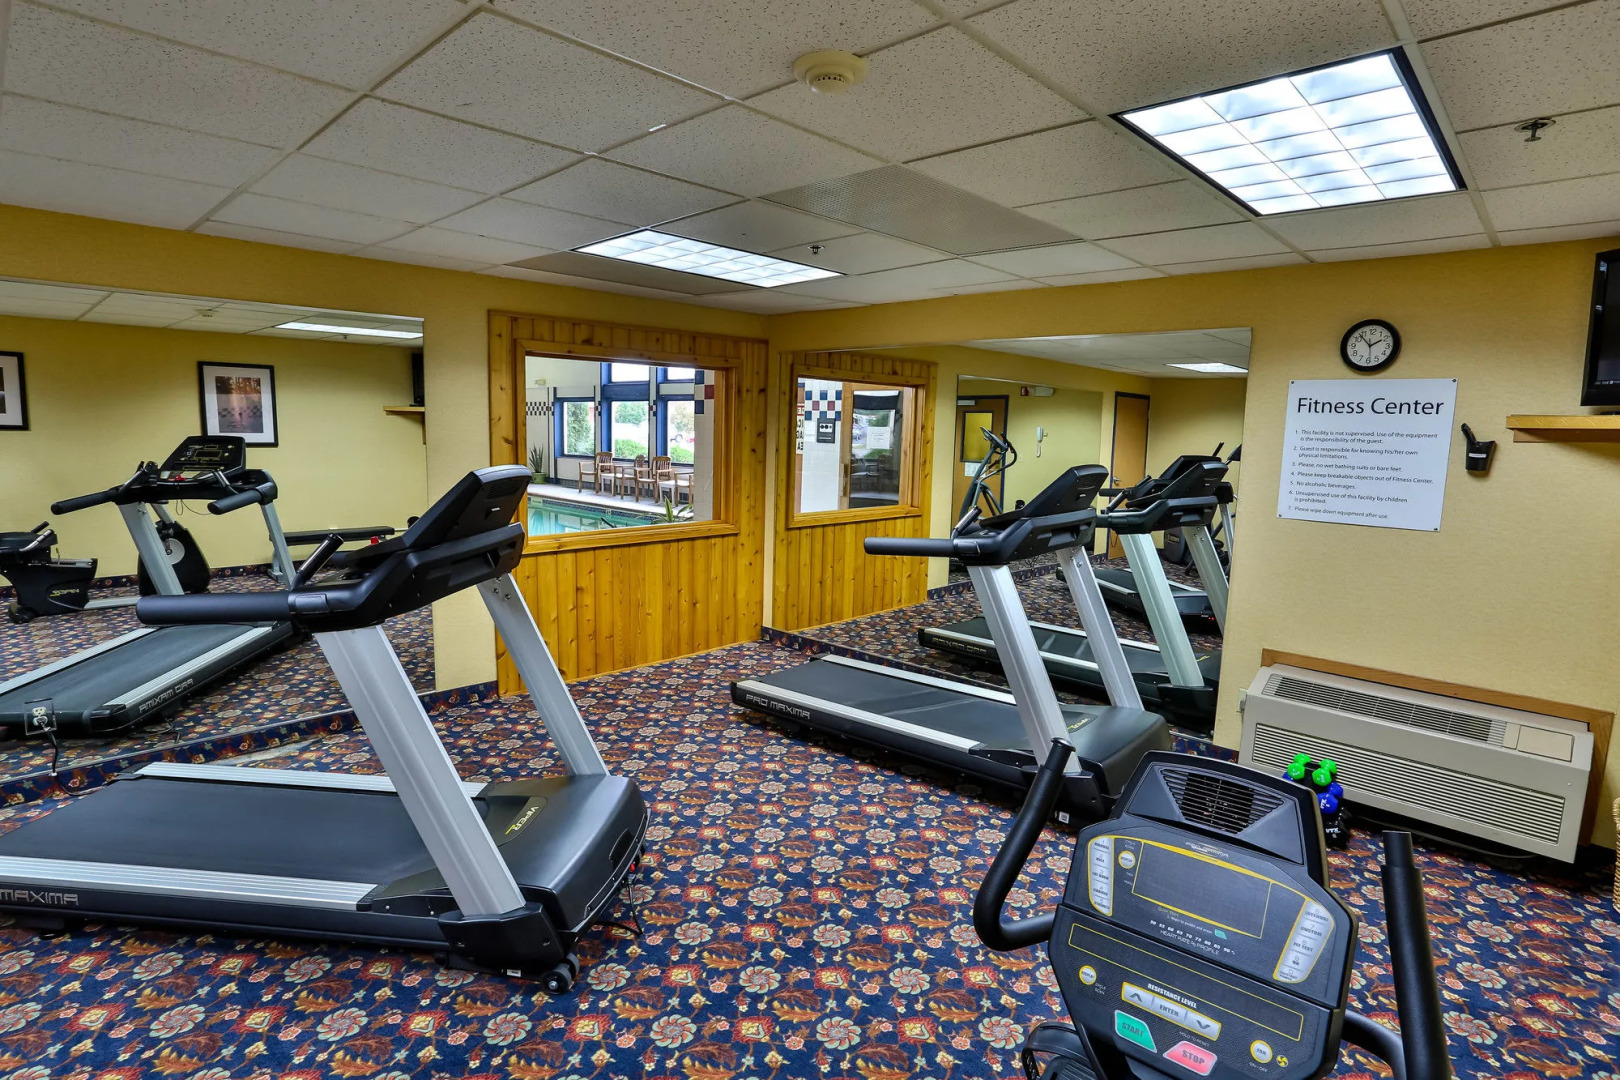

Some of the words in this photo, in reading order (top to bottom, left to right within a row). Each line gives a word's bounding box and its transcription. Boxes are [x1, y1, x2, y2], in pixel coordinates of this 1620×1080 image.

[1366, 357, 1371, 365] 6
[1297, 398, 1364, 414] Fitness
[1370, 398, 1444, 415] Center
[746, 694, 768, 706] PRO
[770, 701, 810, 719] MAXIMA
[509, 806, 539, 832] VIPER
[0, 889, 78, 905] MAXIMA
[1300, 926, 1322, 936] CUSTOM
[1160, 929, 1177, 939] HEART
[1178, 935, 1190, 944] RATE
[1196, 943, 1220, 955] PROFILE
[1148, 983, 1181, 1002] RESISTANCE
[1181, 996, 1197, 1009] LEVEL
[1159, 1004, 1179, 1017] ENTER
[1121, 1022, 1144, 1038] START
[1182, 1050, 1205, 1065] STOP
